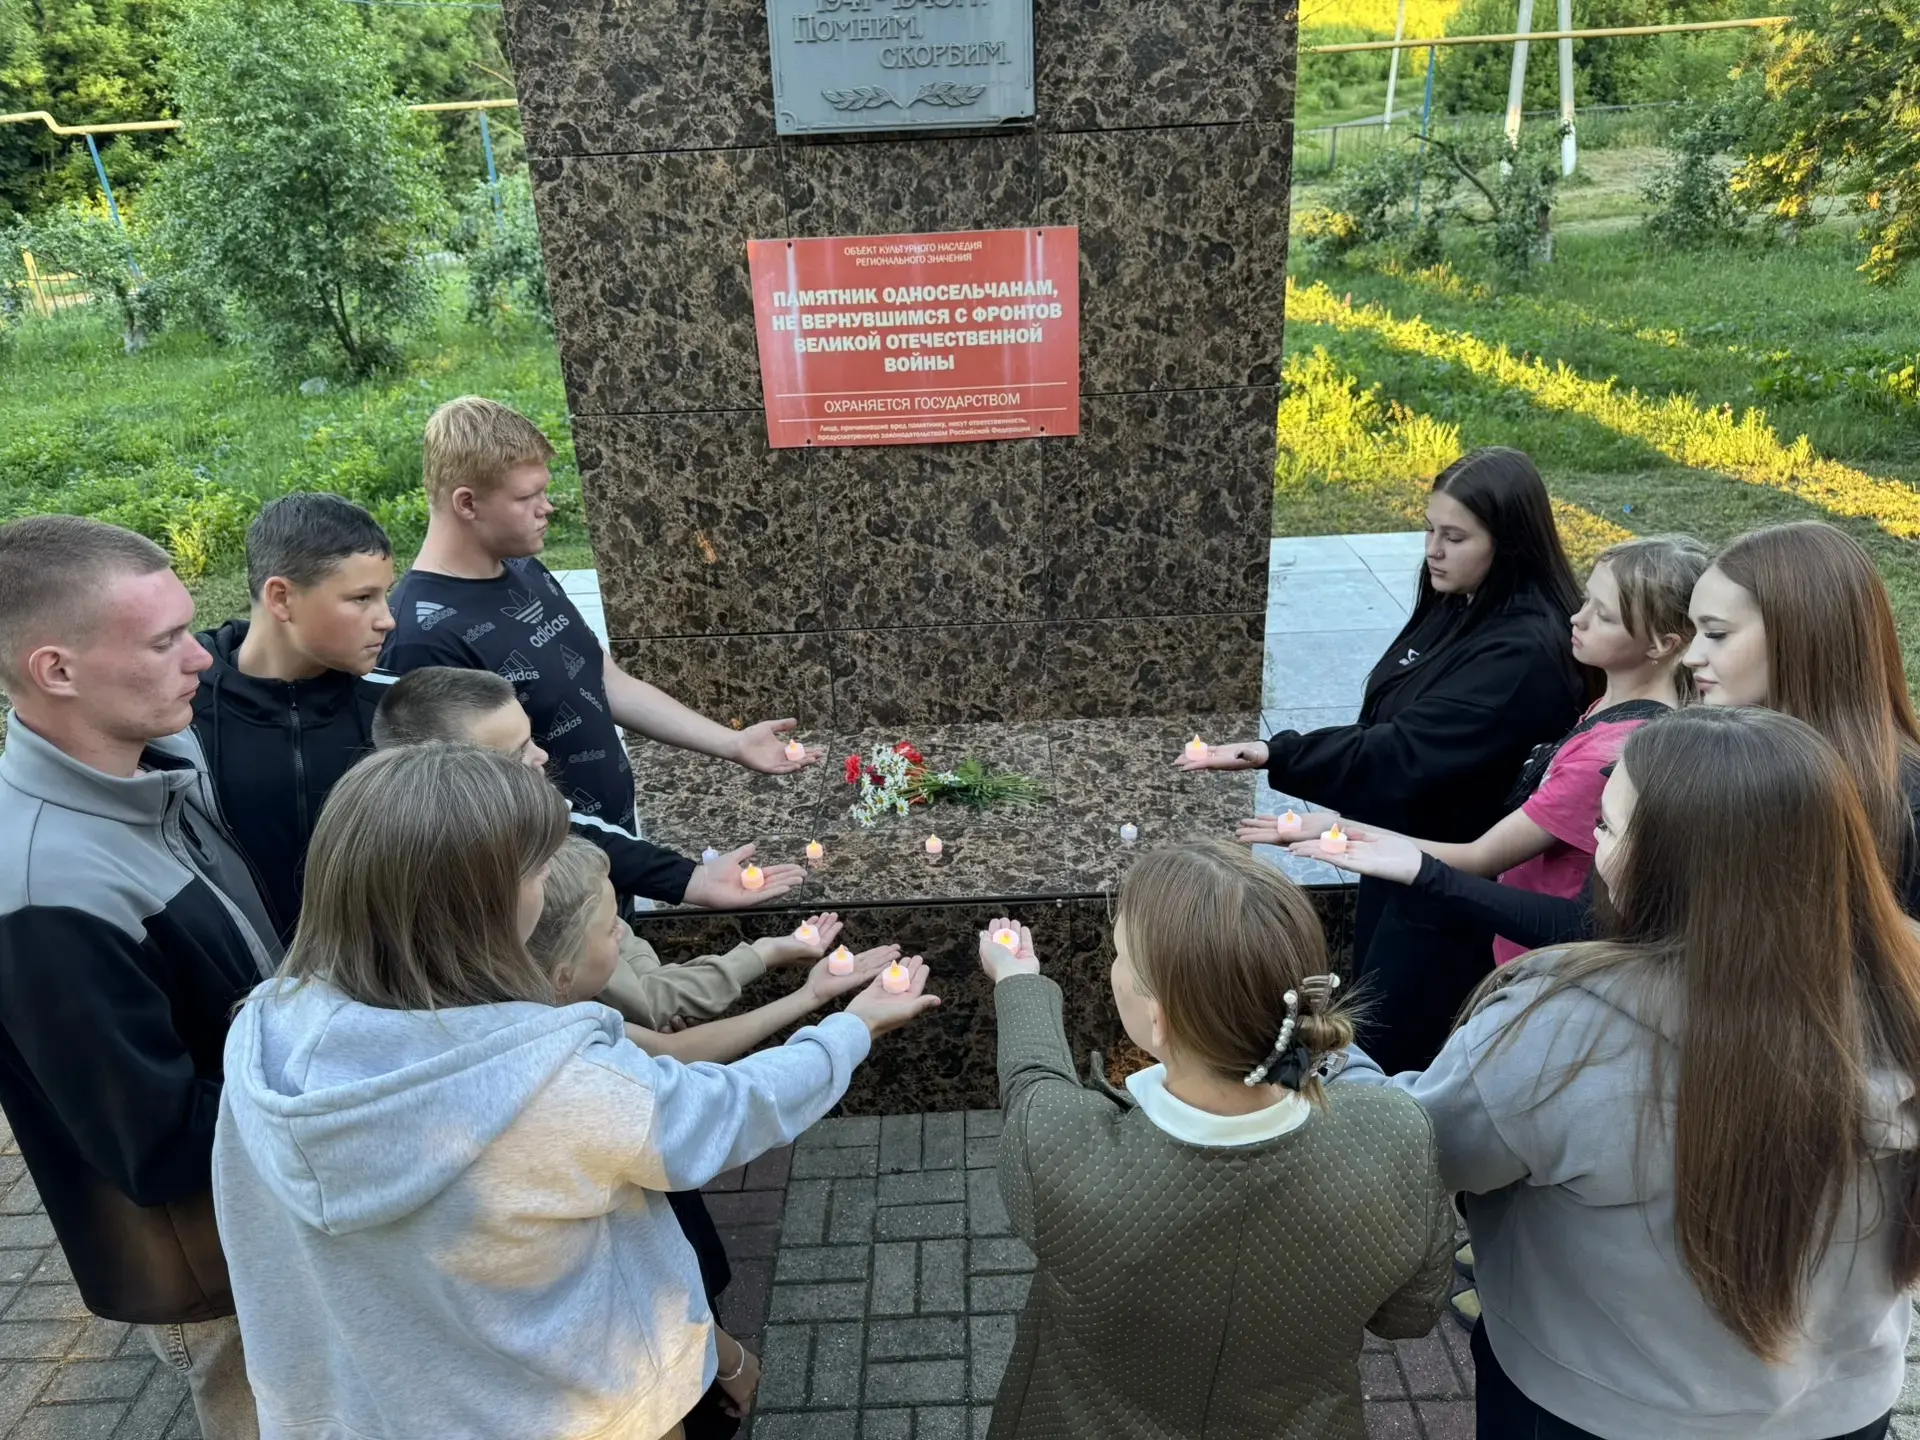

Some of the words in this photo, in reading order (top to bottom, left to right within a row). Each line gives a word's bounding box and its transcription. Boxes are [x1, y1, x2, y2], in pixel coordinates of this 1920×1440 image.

[844, 246, 877, 256] ОБЪЕКТ
[879, 243, 936, 255] КУЛЬТУРНОГО
[938, 241, 982, 251] НАСЛЕДИЯ
[856, 256, 925, 266] РЕГИОНАЛЬНОГО
[927, 253, 972, 263] ЗНАЧЕНИЯ
[773, 288, 878, 307] ПАМЯТНИК
[882, 280, 1057, 305] ОДНОСЕЛЬЧАНАМ,
[772, 316, 797, 331] НЕ
[801, 310, 949, 330] ВЕРНУВШИМСЯ
[954, 308, 969, 323] С
[972, 303, 1062, 322] ФРОНТОВ
[794, 331, 881, 353] ВЕЛИКОЙ
[885, 323, 1043, 350] ОТЕЧЕСТВЕННОЙ
[884, 352, 955, 373] ВОЙНЫ
[824, 397, 911, 413] ОХРАНЯЕТСЯ
[914, 393, 1020, 410] ГОСУДАРСТВОМ
[529, 613, 570, 648] adidas
[504, 669, 540, 681] didas
